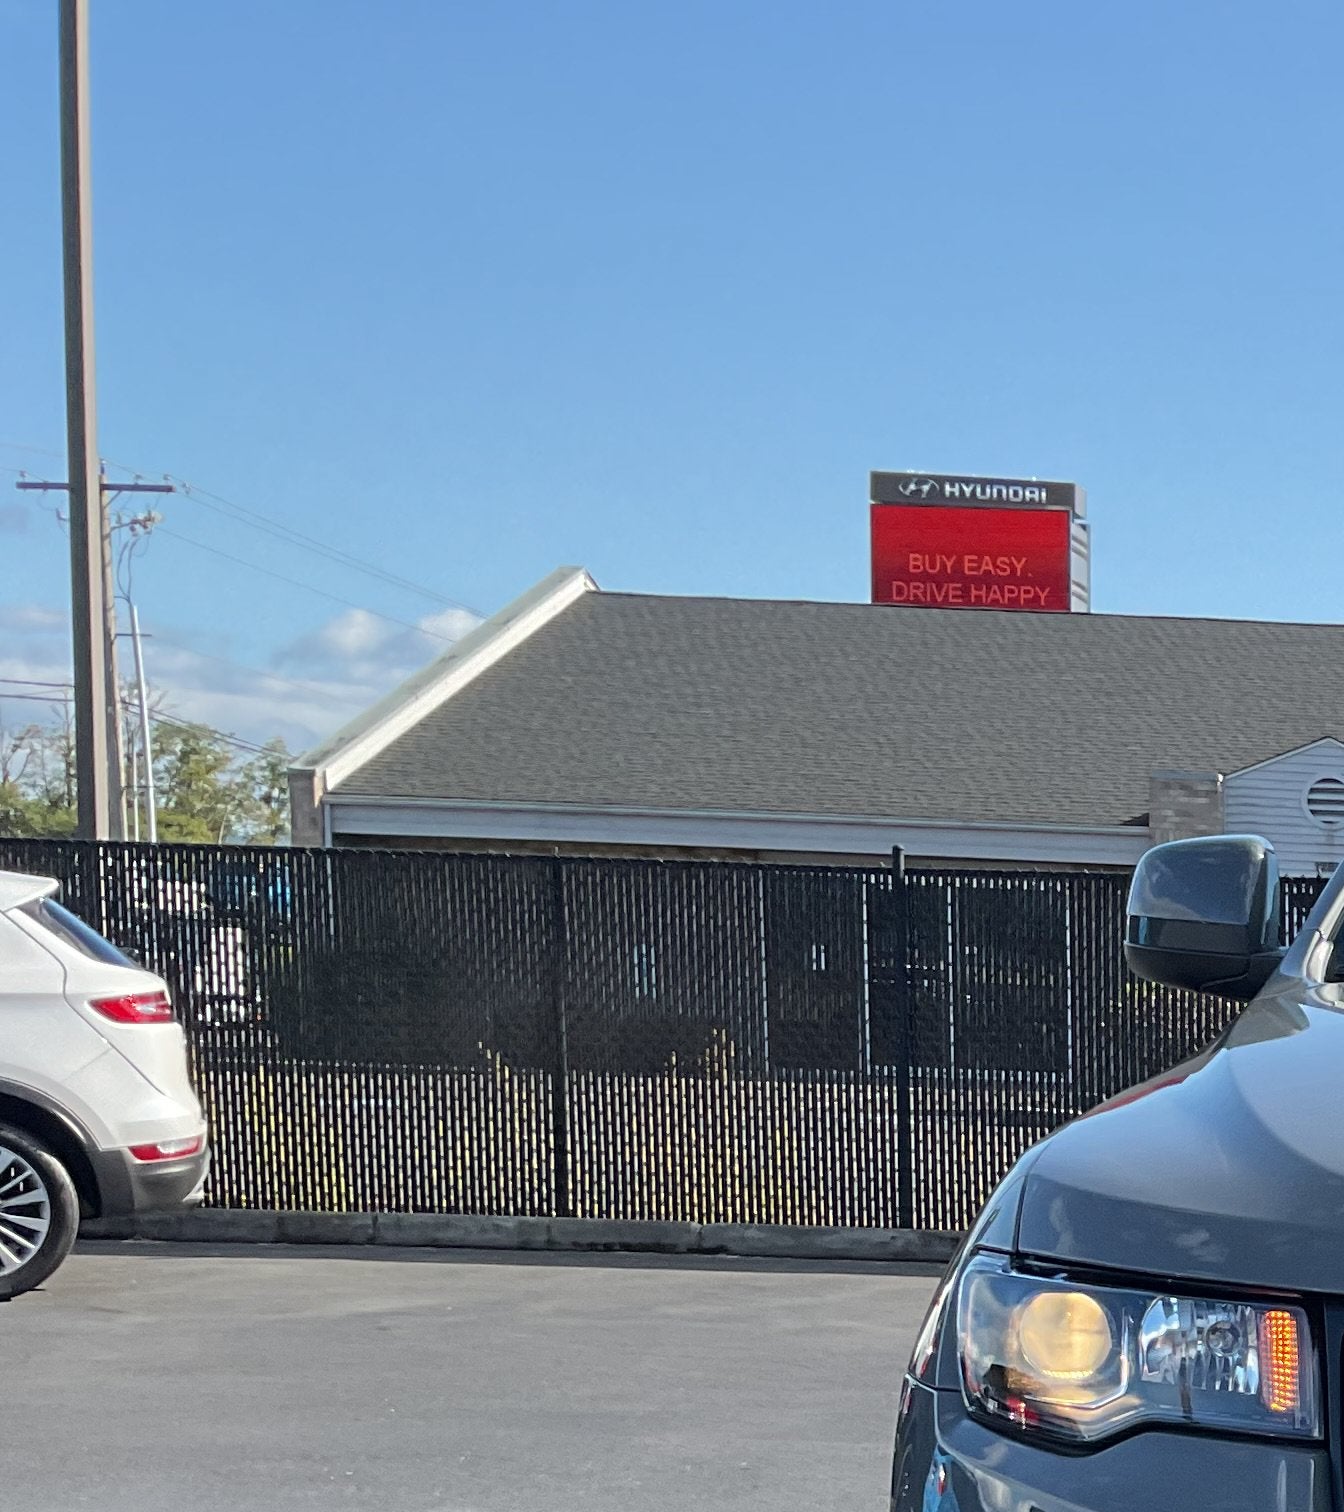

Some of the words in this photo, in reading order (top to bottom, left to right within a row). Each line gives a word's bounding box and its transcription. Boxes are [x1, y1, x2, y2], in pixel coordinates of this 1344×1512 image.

[944, 481, 1047, 504] HYUNDAI
[909, 553, 956, 574] BUY
[964, 555, 1033, 577] EASY.
[892, 581, 963, 603] DRIVE
[970, 584, 1050, 605] HAPPY
